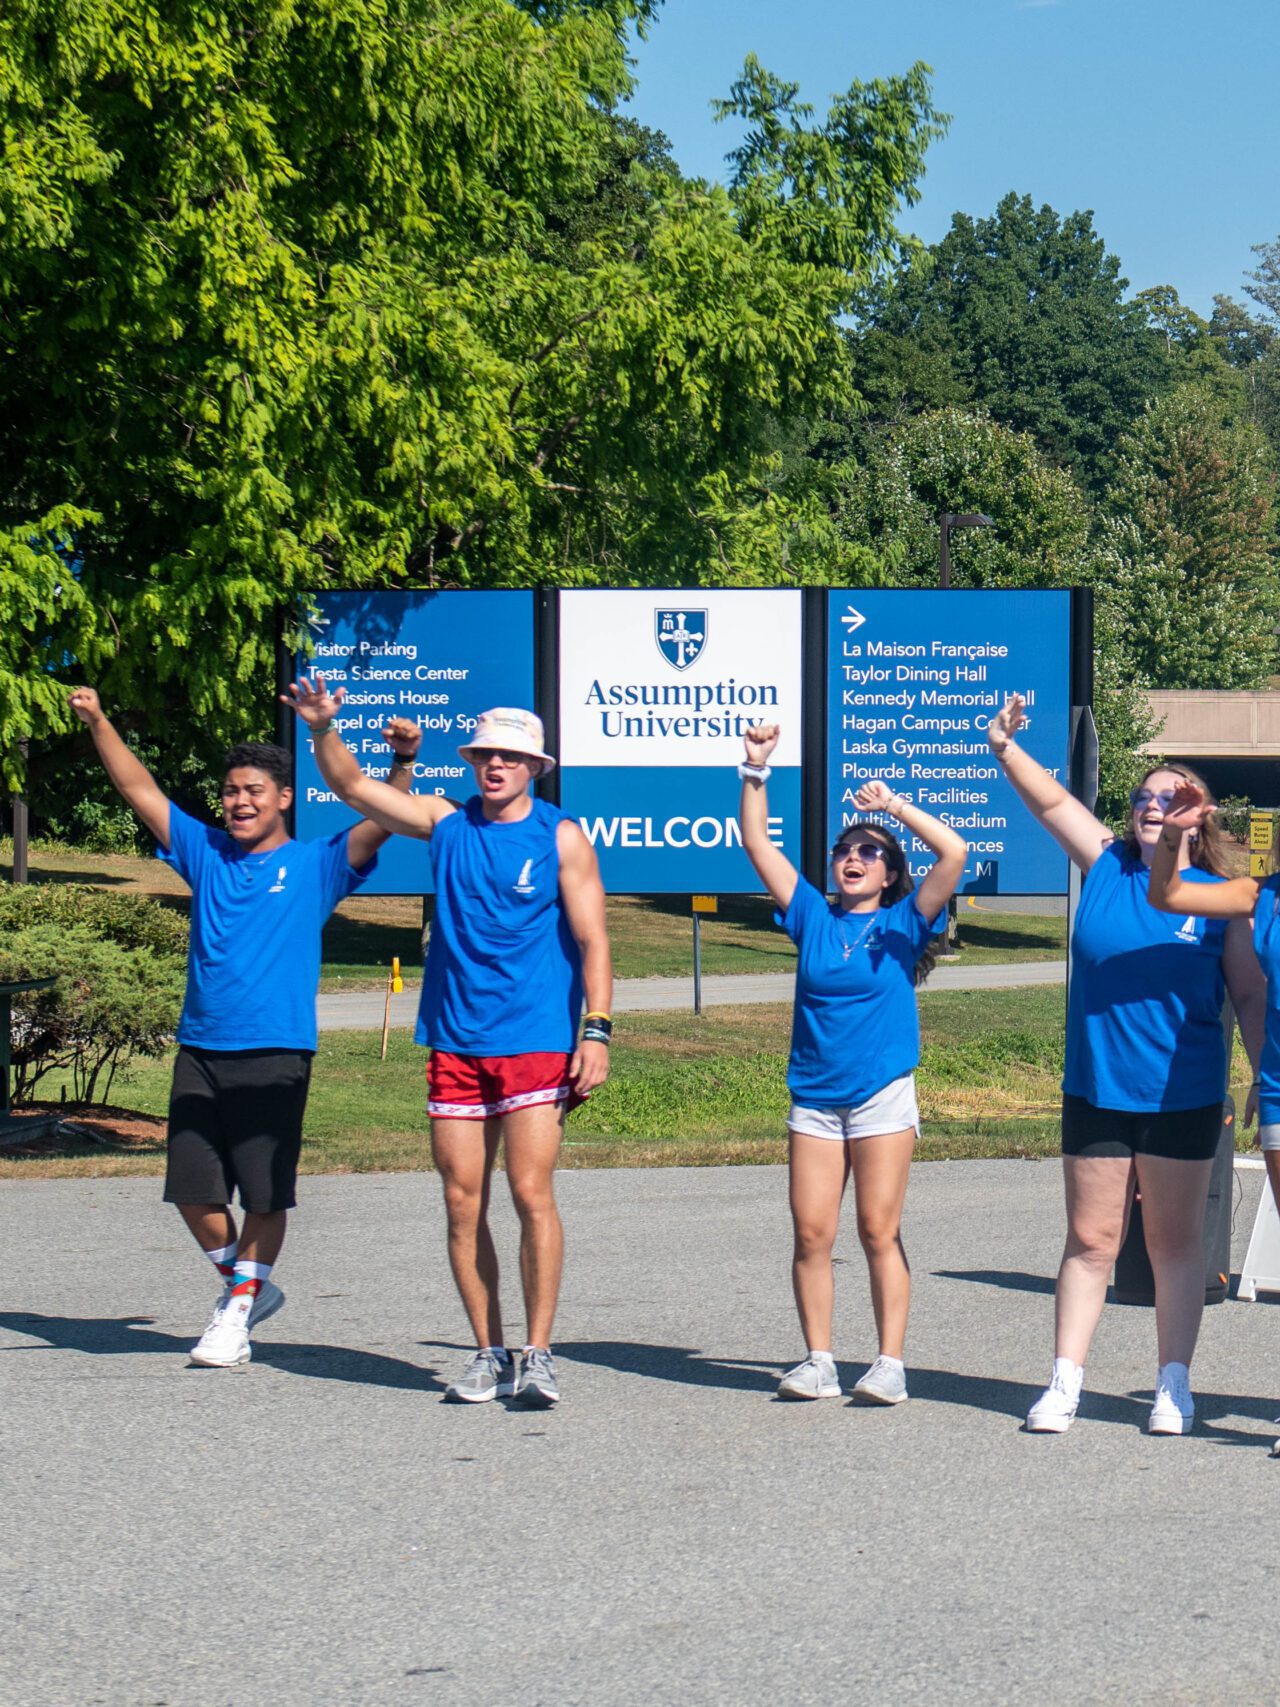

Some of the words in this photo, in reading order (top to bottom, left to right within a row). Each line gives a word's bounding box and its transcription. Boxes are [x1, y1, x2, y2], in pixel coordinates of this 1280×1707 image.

[360, 641, 418, 660] Parking
[842, 641, 862, 657] La
[867, 641, 927, 657] Maison
[931, 641, 1009, 661] Française
[307, 665, 348, 681] Testa
[351, 665, 412, 681] Science
[415, 665, 469, 681] Center
[842, 665, 892, 685] Taylor
[896, 665, 950, 685] Dining
[956, 665, 987, 681] Hall
[399, 690, 450, 705] House
[584, 678, 780, 713] Assumption
[842, 689, 916, 710] Kennedy
[921, 690, 999, 706] Memorial
[366, 713, 385, 730] of
[417, 714, 452, 733] Holy
[842, 714, 896, 734] Hagan
[901, 714, 970, 735] Campus
[974, 714, 1032, 730] Ceer
[842, 738, 888, 755] Laska
[892, 739, 990, 758] Gymnasium
[412, 762, 466, 778] Center
[842, 763, 906, 779] Plourde
[911, 763, 998, 779] Recreation
[918, 788, 989, 804] Facilities
[939, 812, 1007, 828] Stadium
